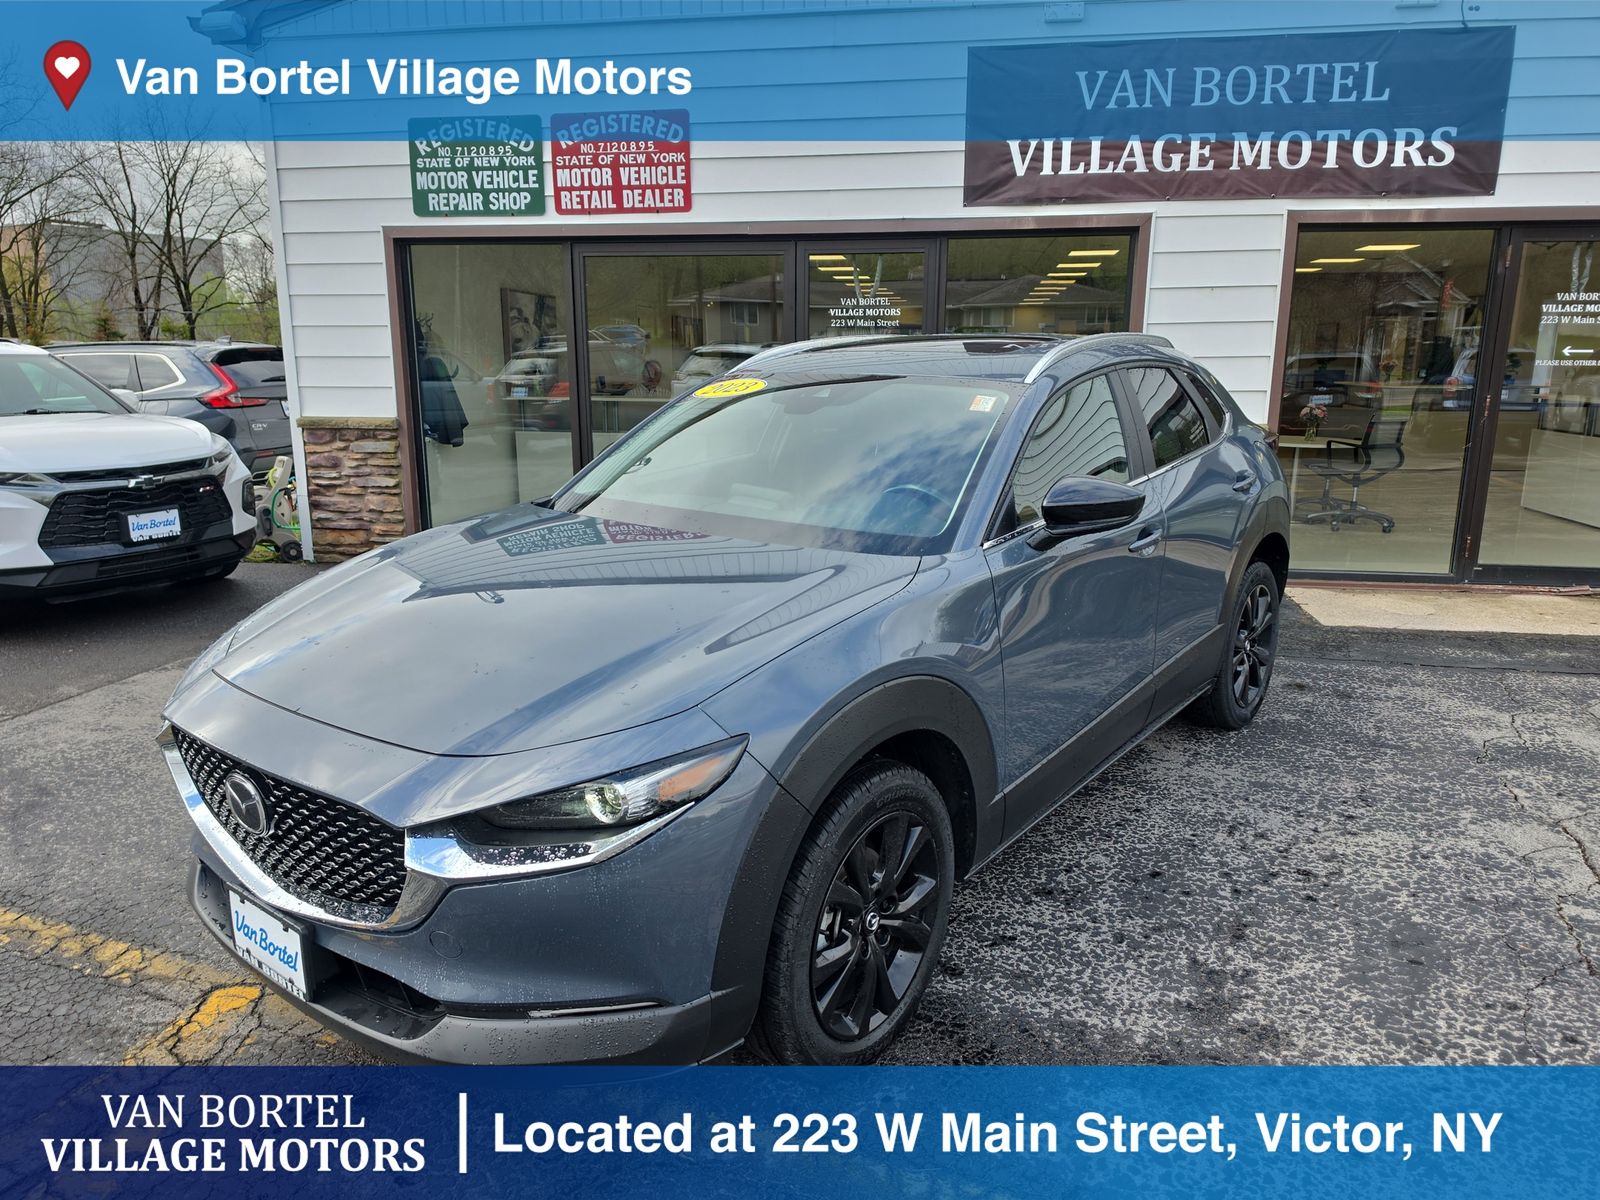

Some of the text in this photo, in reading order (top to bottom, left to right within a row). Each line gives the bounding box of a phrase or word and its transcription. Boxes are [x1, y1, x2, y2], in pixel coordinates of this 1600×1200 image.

[1076, 61, 1390, 110] VAN BORTEL
[415, 118, 534, 156] REGISTERED
[557, 113, 684, 149] REGISTERED
[438, 145, 512, 157] NO. 7120895
[580, 141, 655, 154] NO. 7120895
[1006, 126, 1458, 177] VILLAGE MOTORS
[416, 156, 536, 168] STATE OF NEW YORK
[556, 152, 686, 166] STATE OF NEW YORK
[416, 169, 539, 190] MOTOR VEHICLE
[556, 165, 686, 187] MOTOR VEHICLE
[428, 192, 531, 211] REPAIR SHOP
[560, 188, 685, 209] RETAIL DEALER
[840, 297, 891, 306] VAN BORTEL
[1557, 292, 1600, 301] VAN BOR
[830, 308, 901, 316] VILLAGE MOTORS
[1541, 304, 1584, 313] VILLAGE
[831, 319, 900, 327] 223 W Main Street
[1540, 315, 1559, 324] 223
[1561, 315, 1571, 324] W
[1573, 315, 1595, 324] Main
[701, 382, 758, 394] 2023
